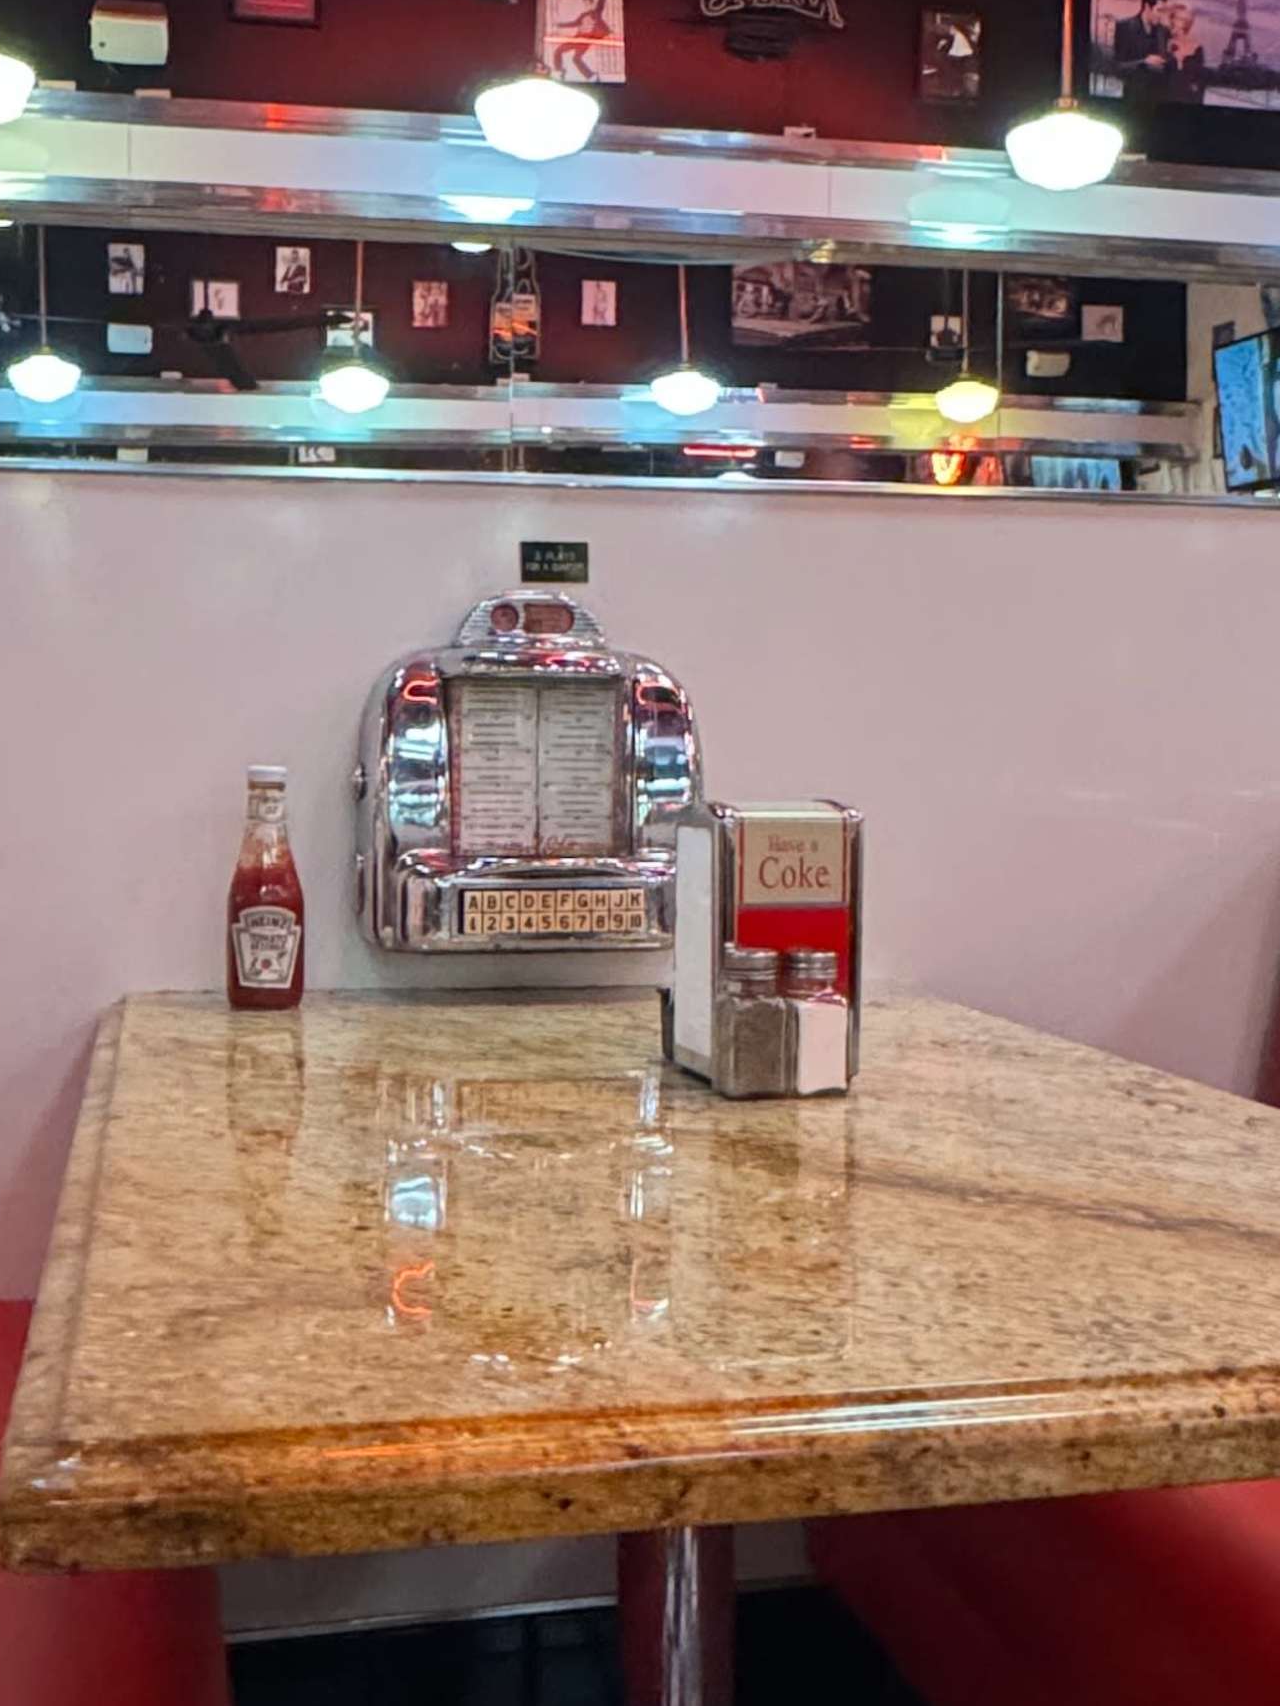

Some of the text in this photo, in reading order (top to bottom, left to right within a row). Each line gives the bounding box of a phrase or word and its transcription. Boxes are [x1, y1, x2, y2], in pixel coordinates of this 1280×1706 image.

[768, 834, 818, 853] Have a
[759, 855, 831, 890] Coke
[468, 892, 642, 910] A B C D E F G H J K
[249, 915, 288, 929] HEINZ
[488, 917, 497, 930] 2
[506, 917, 515, 930] 3
[524, 916, 534, 929] 4
[542, 916, 552, 929] 5
[560, 916, 570, 929] 6
[578, 915, 587, 928] 7
[597, 915, 605, 928] 8
[613, 914, 623, 927] 9
[630, 914, 642, 927] 10
